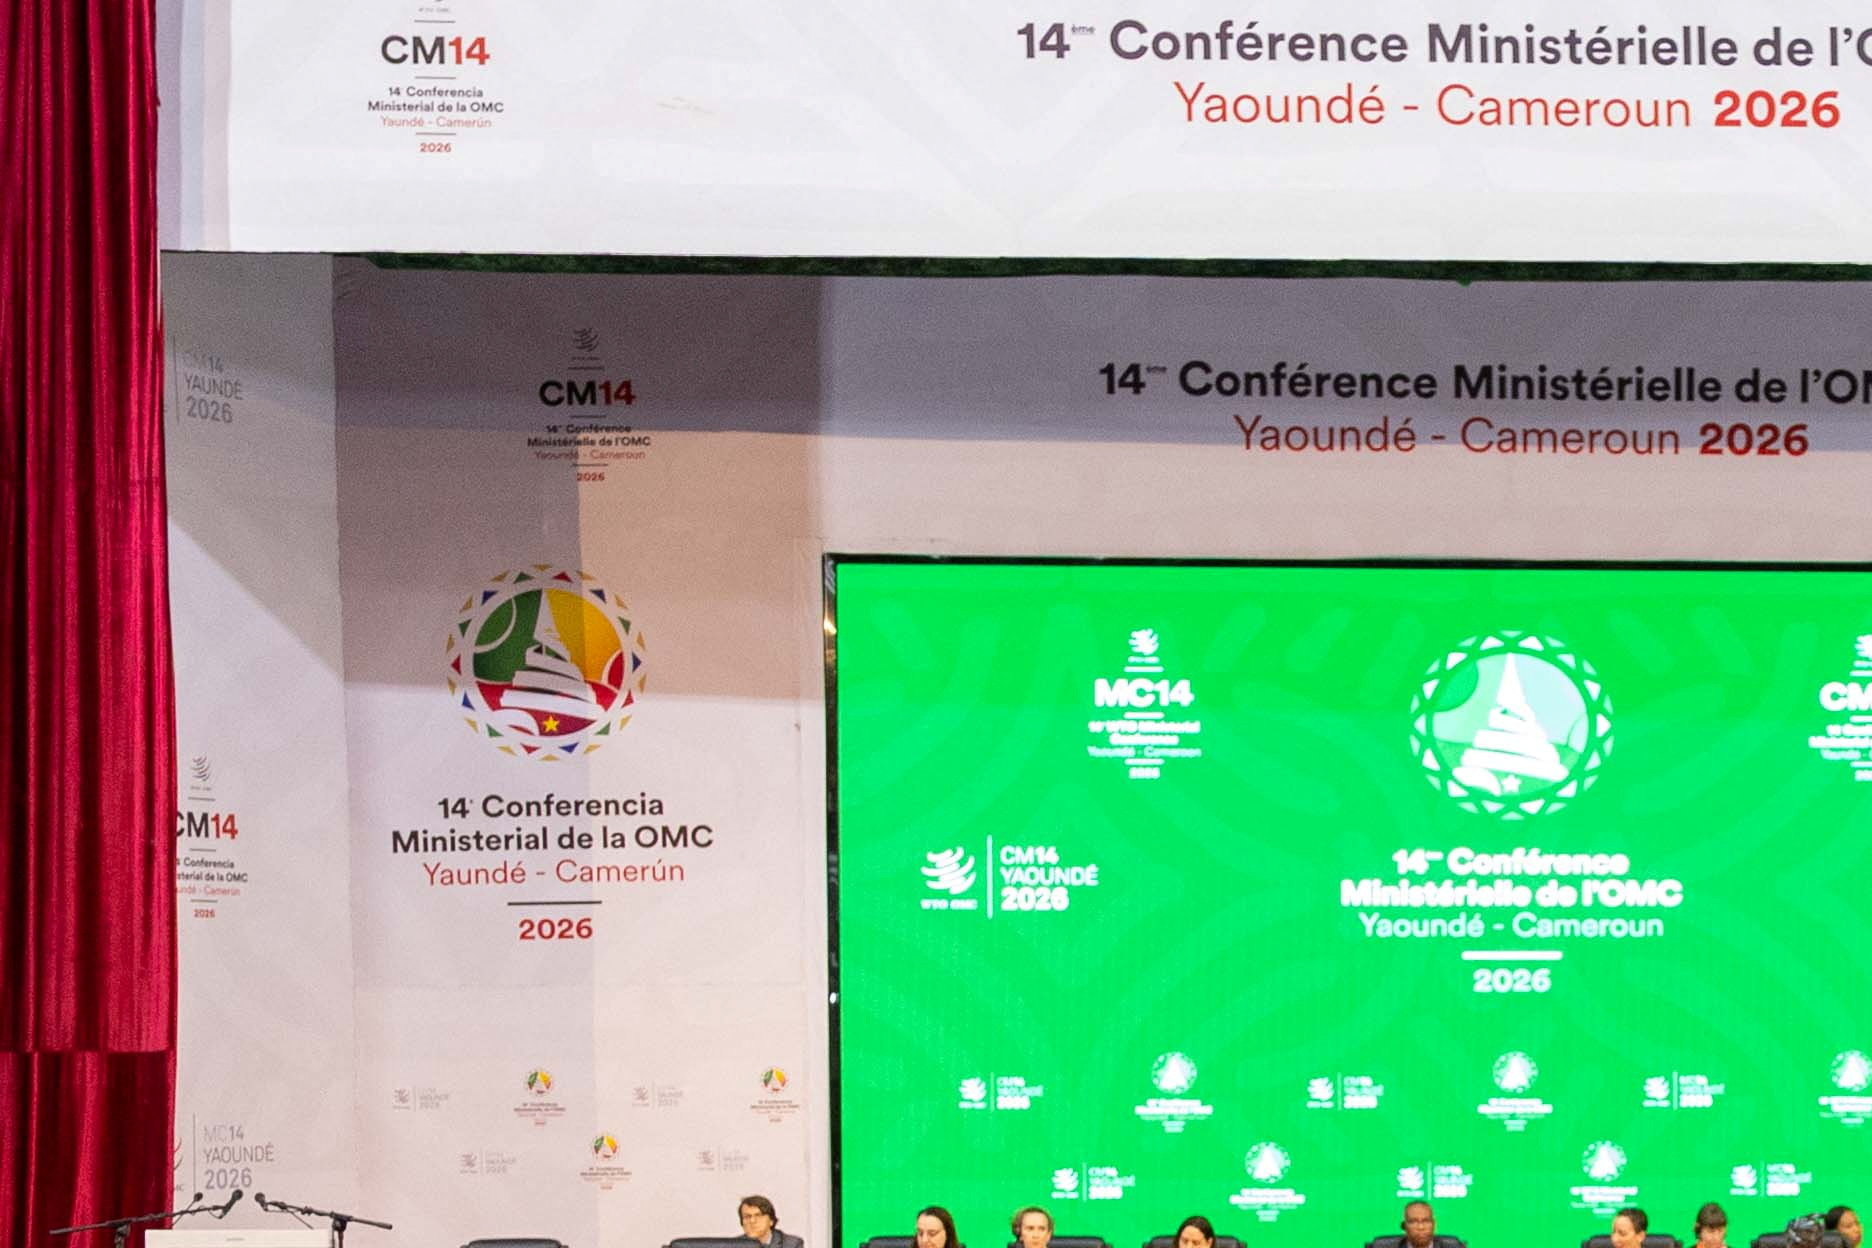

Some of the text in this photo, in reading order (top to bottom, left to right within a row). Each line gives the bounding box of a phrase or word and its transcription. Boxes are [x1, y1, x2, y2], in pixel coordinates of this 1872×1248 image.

[381, 35, 491, 65] CM14
[1109, 18, 1408, 62] Conférence
[1428, 22, 1738, 67] Ministérielle
[1752, 27, 1814, 67] de
[406, 86, 484, 98] Conferencia
[1174, 80, 1386, 125] Yaoundé
[1437, 83, 1691, 128] Cameroun
[1713, 88, 1841, 128] 2026
[368, 101, 505, 114] Ministerial de la OMC
[419, 143, 452, 153] 2026
[539, 378, 637, 407] CM14
[1179, 360, 1437, 399] Conférence
[1453, 363, 1722, 404] Ministérielle
[1734, 368, 1787, 404] de
[186, 395, 233, 423] 2026
[598, 436, 613, 447] de
[1234, 414, 1416, 452] Yaoundé
[1461, 416, 1681, 456] Cameroun
[1698, 423, 1810, 457] 2026
[1094, 678, 1195, 708] MC14
[482, 792, 665, 818] Conferencia
[391, 824, 714, 853] Ministerial de la OMC
[999, 845, 1060, 865] CM14
[1447, 846, 1631, 876] Conférence
[422, 861, 527, 887] Yaundé
[555, 858, 686, 883] Camerún
[999, 863, 1099, 887] YAOUNDÉ
[1000, 886, 1069, 911] 2026
[1340, 878, 1534, 908] Ministérielle
[1535, 879, 1579, 907] de
[518, 918, 593, 941] 2026
[1359, 911, 1485, 938] Yaoundé
[1512, 911, 1665, 938] Cameroun
[1473, 967, 1553, 993] 2026
[203, 1142, 275, 1164] YAOUNDÉ
[205, 1167, 252, 1190] 2026
